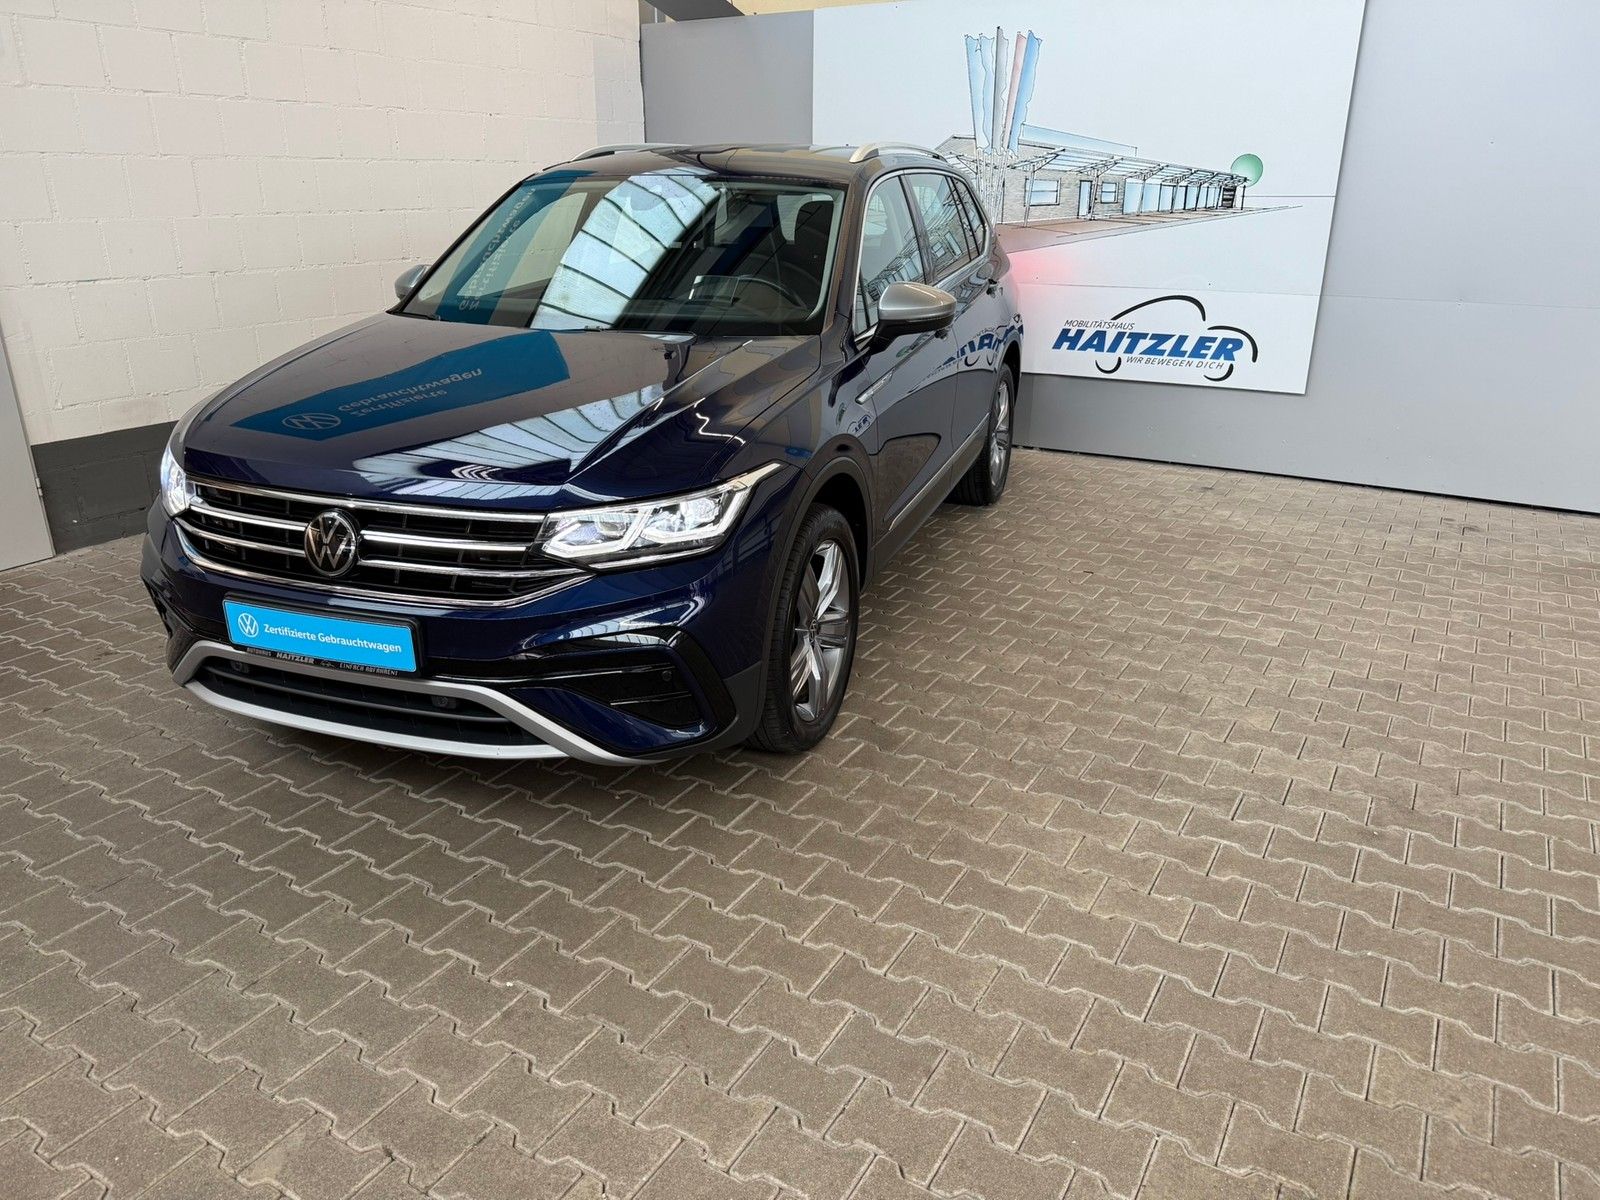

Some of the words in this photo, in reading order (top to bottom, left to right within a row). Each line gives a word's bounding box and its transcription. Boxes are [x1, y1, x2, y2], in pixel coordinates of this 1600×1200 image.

[1064, 319, 1136, 331] MOBILITÄTSHAUS
[1052, 328, 1244, 362] HAITZLER
[1126, 355, 1143, 365] WIR
[1144, 357, 1194, 368] BEWEGEN
[1195, 359, 1225, 370] DICH
[263, 623, 317, 642] Zertifizierte
[318, 632, 402, 653] Gebrauchtwagen
[276, 652, 315, 665] HAITZLER
